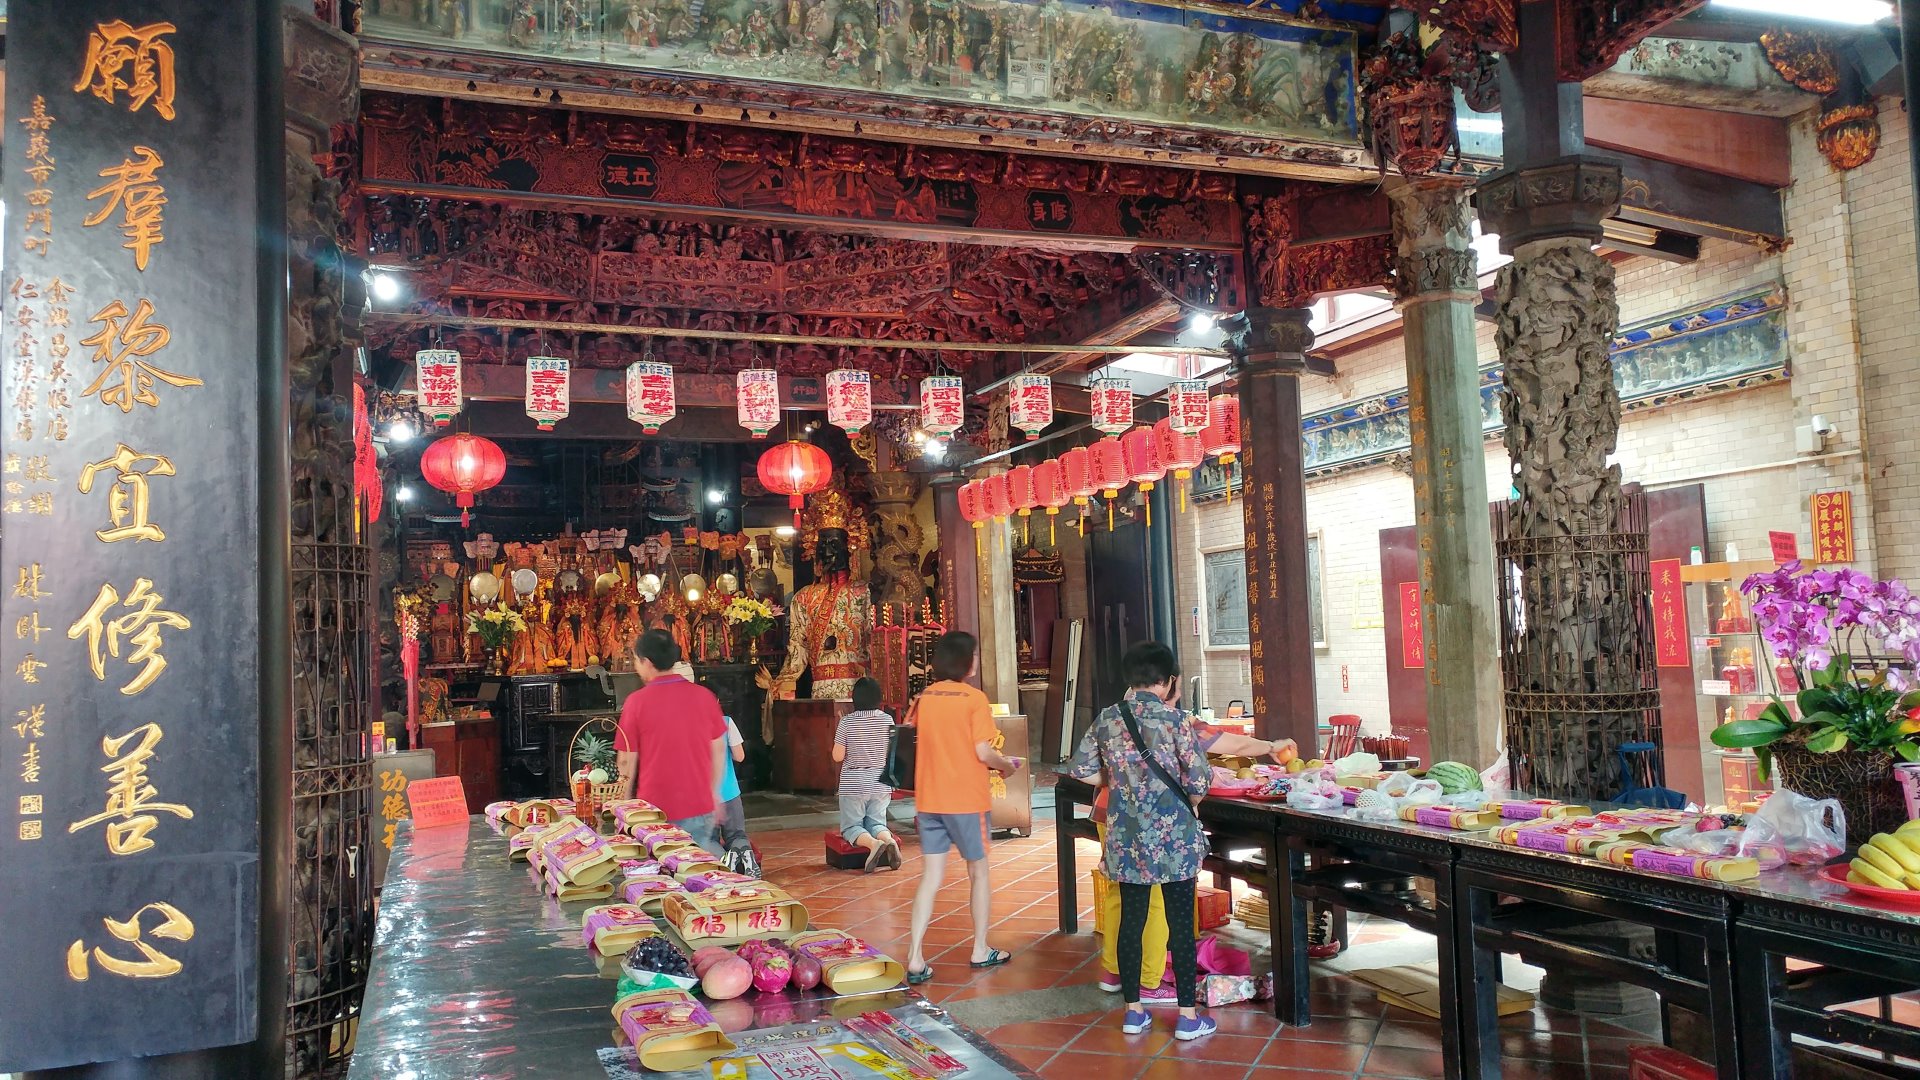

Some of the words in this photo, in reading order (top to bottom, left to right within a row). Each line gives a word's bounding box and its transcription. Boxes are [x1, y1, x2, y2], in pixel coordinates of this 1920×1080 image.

[18, 94, 57, 257] 嘉義市西門町
[691, 914, 727, 936] 福
[748, 905, 782, 931] 福
